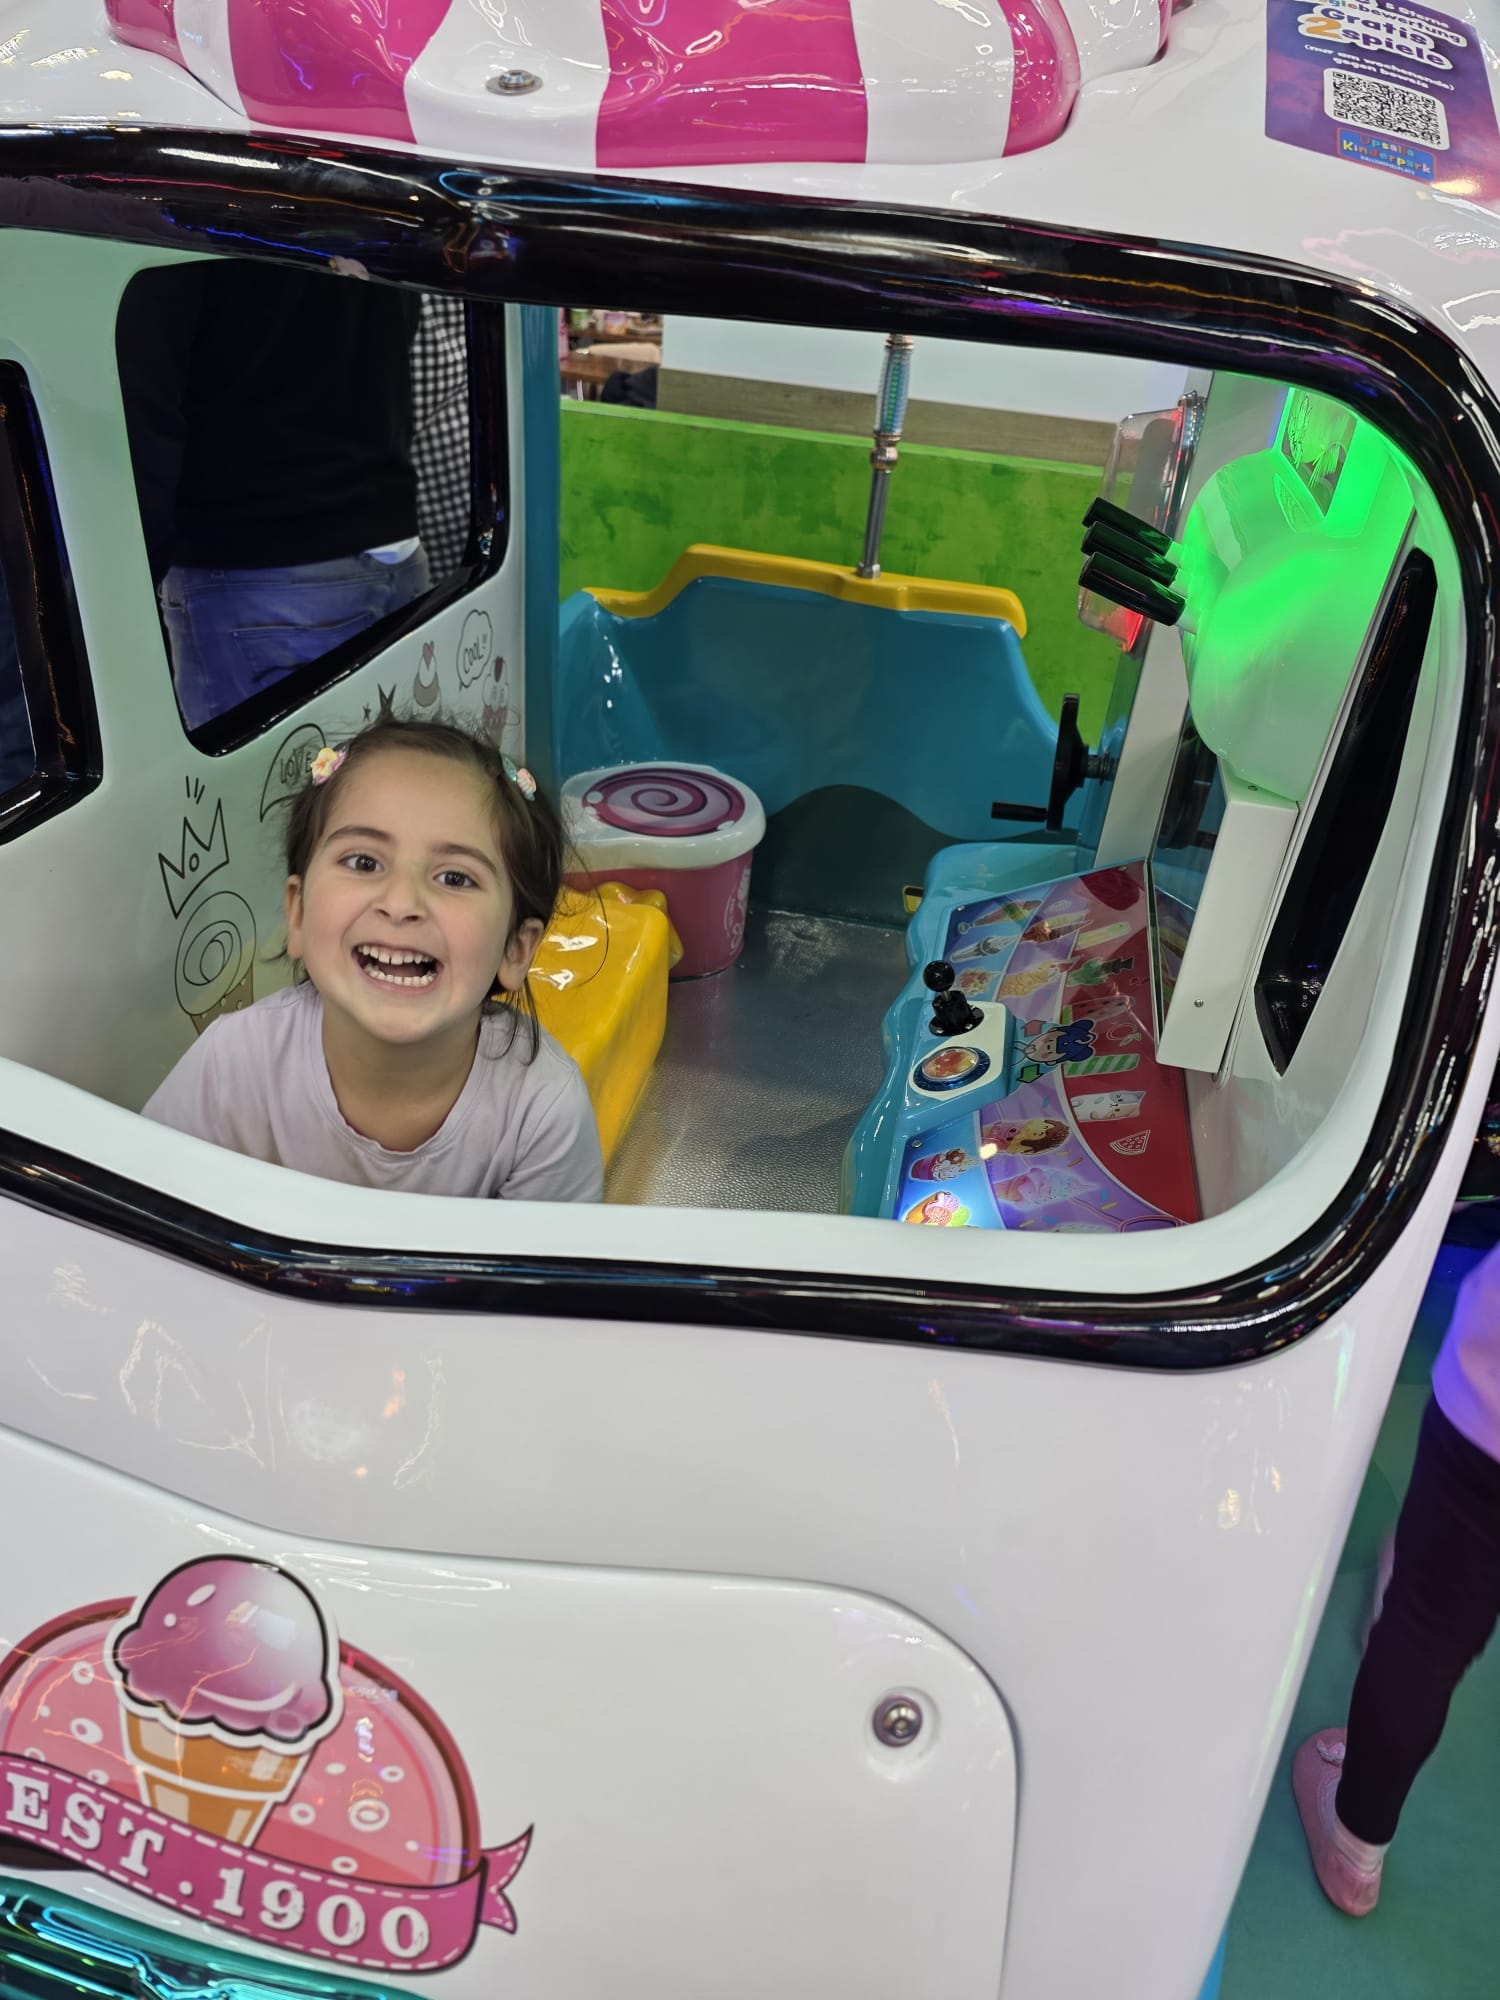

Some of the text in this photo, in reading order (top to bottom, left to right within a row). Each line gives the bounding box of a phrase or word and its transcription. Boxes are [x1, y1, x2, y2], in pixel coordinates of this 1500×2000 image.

[1320, 0, 1460, 43] glebewertung
[1321, 7, 1428, 45] Gratis
[1398, 6, 1449, 29] Sterne
[1305, 16, 1444, 65] 2 spiele
[1337, 52, 1360, 61] am
[1332, 57, 1430, 89] gegen beweis
[1342, 139, 1431, 174] Kinderpark
[280, 748, 313, 785] LOVE
[213, 1867, 431, 1960] 1900
